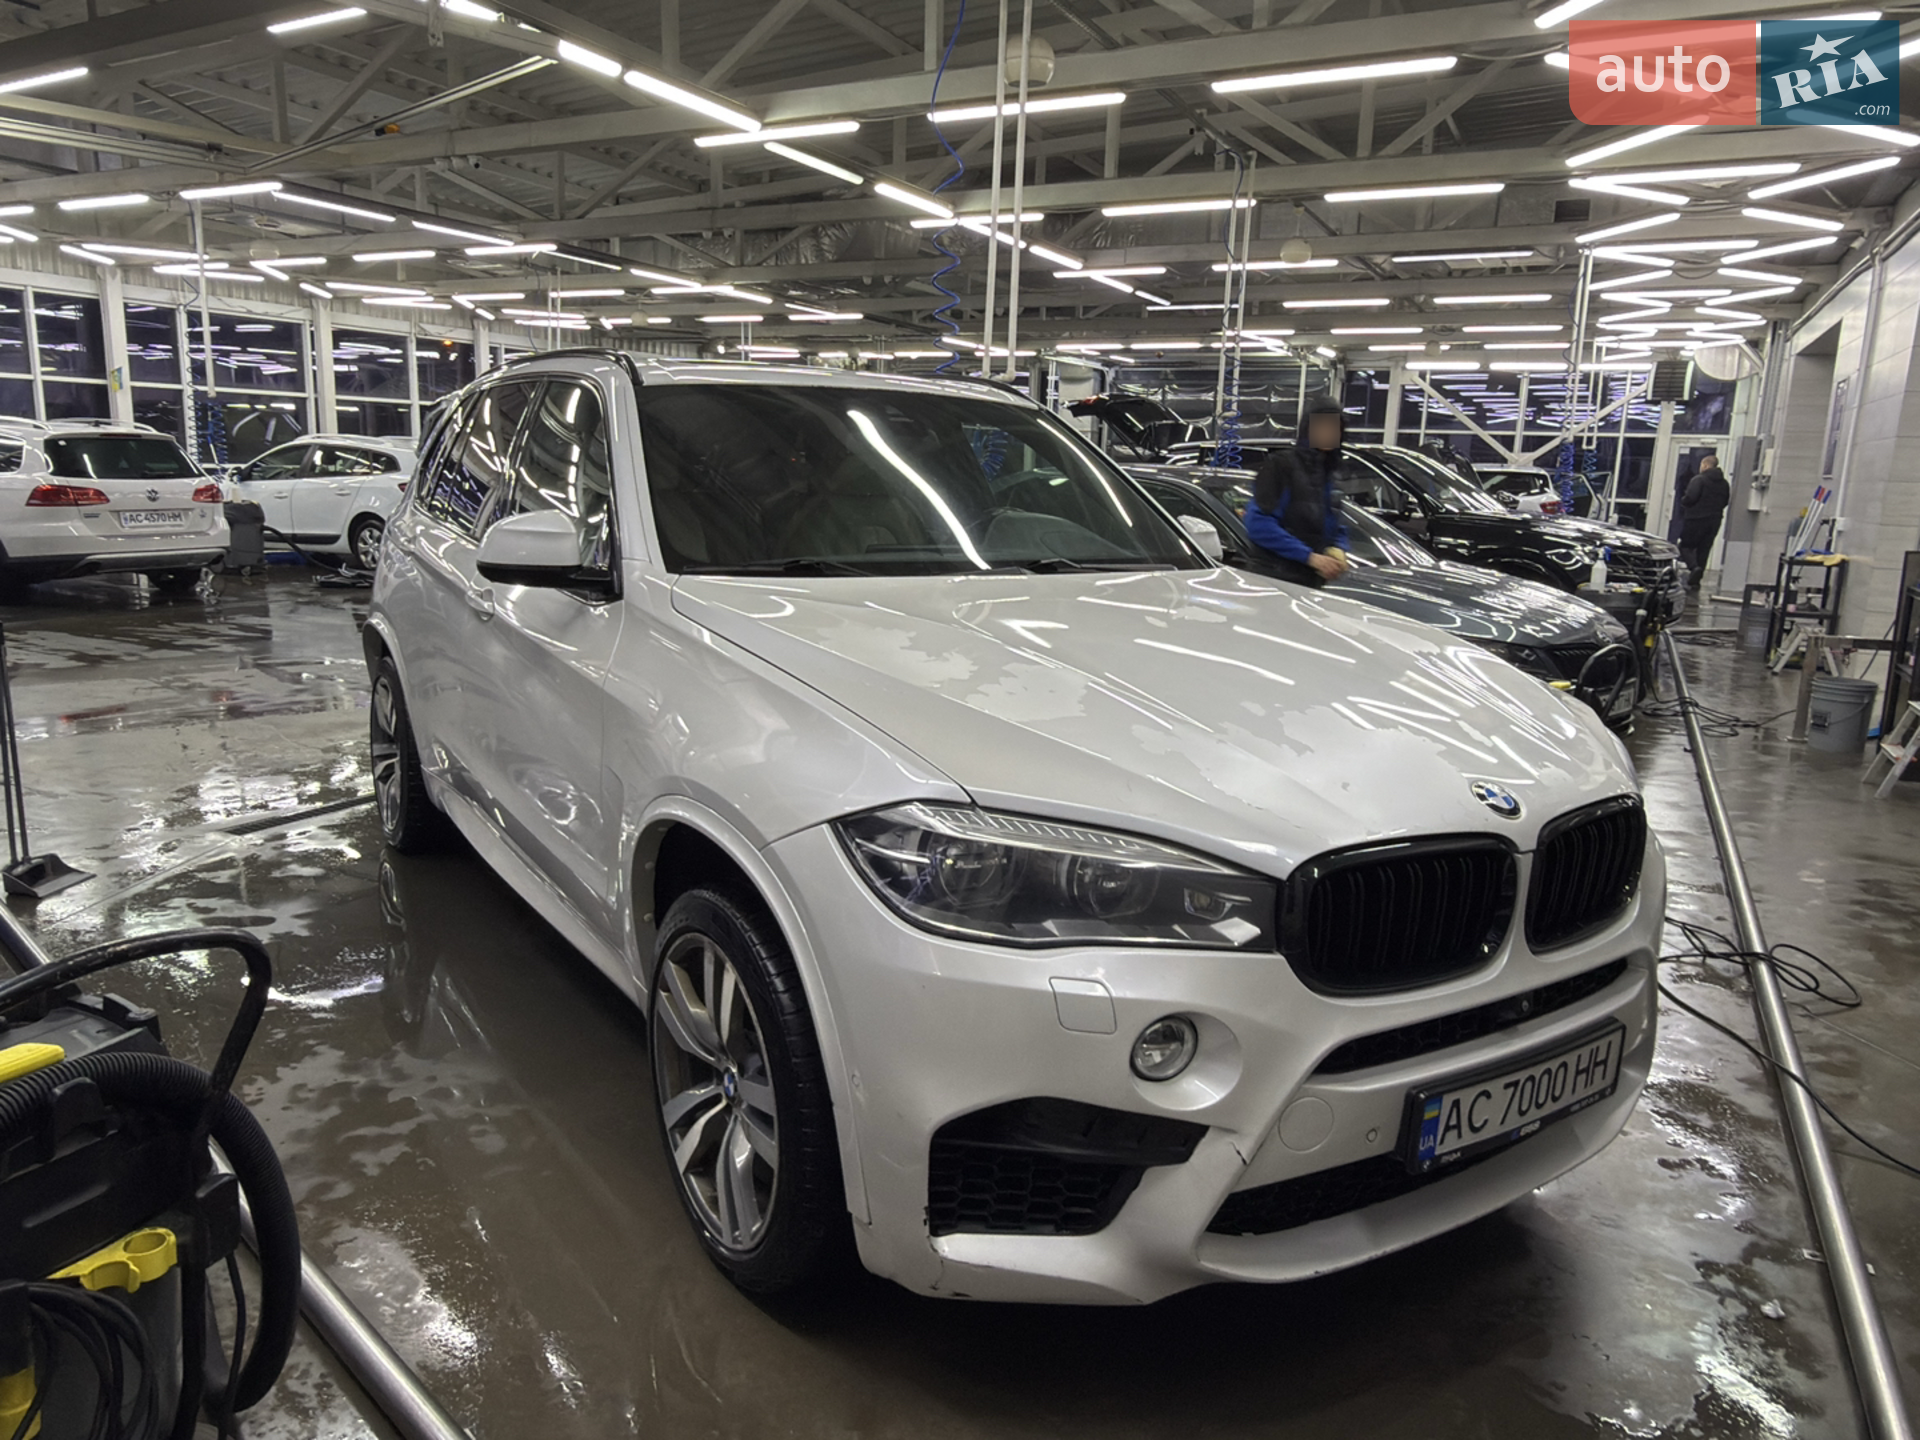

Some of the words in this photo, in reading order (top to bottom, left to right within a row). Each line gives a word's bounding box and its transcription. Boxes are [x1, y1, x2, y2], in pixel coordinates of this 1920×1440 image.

[129, 513, 143, 523] AC
[1439, 1089, 1492, 1146] AC
[1500, 1061, 1569, 1125] 7000
[1572, 1040, 1612, 1095] HH
[1419, 1134, 1434, 1150] UA
